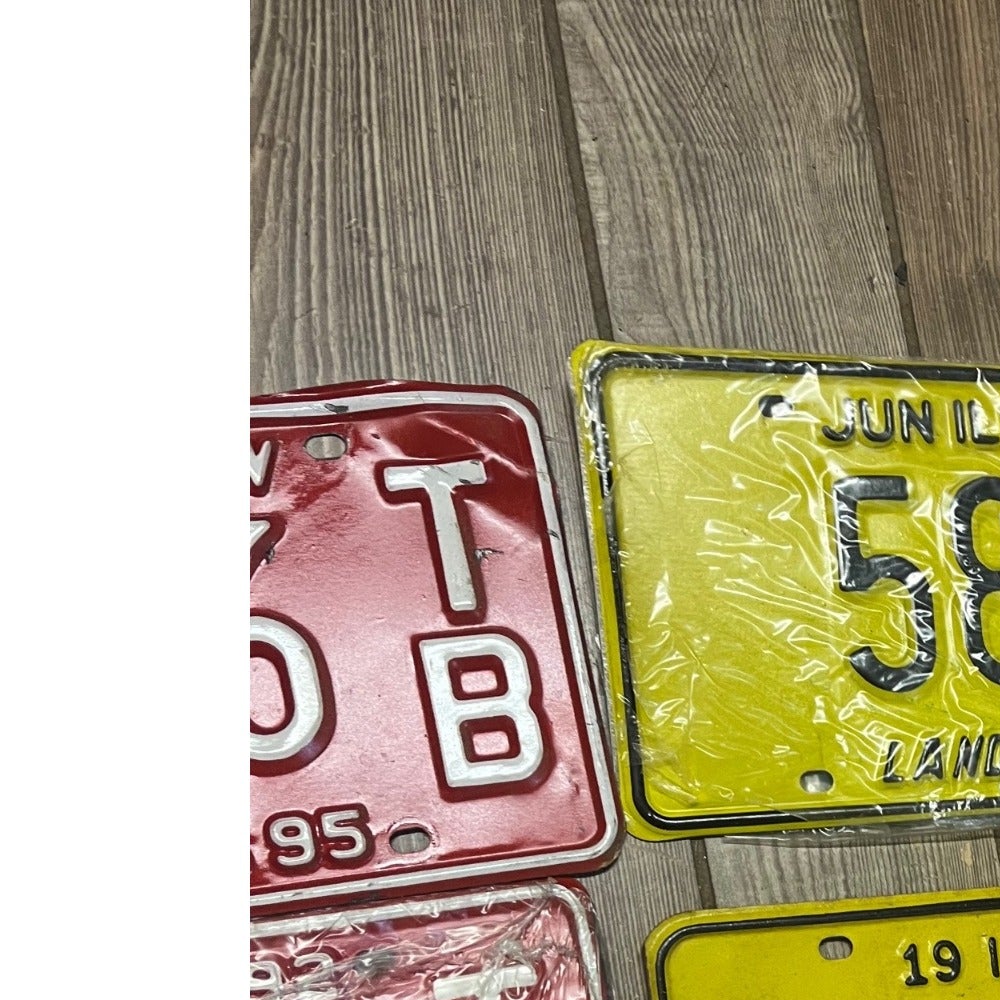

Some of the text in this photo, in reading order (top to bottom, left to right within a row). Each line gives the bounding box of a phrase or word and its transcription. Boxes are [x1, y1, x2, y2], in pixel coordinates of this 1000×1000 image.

[821, 398, 935, 446] JUN
[269, 809, 367, 867] 95
[902, 940, 960, 986] 19
